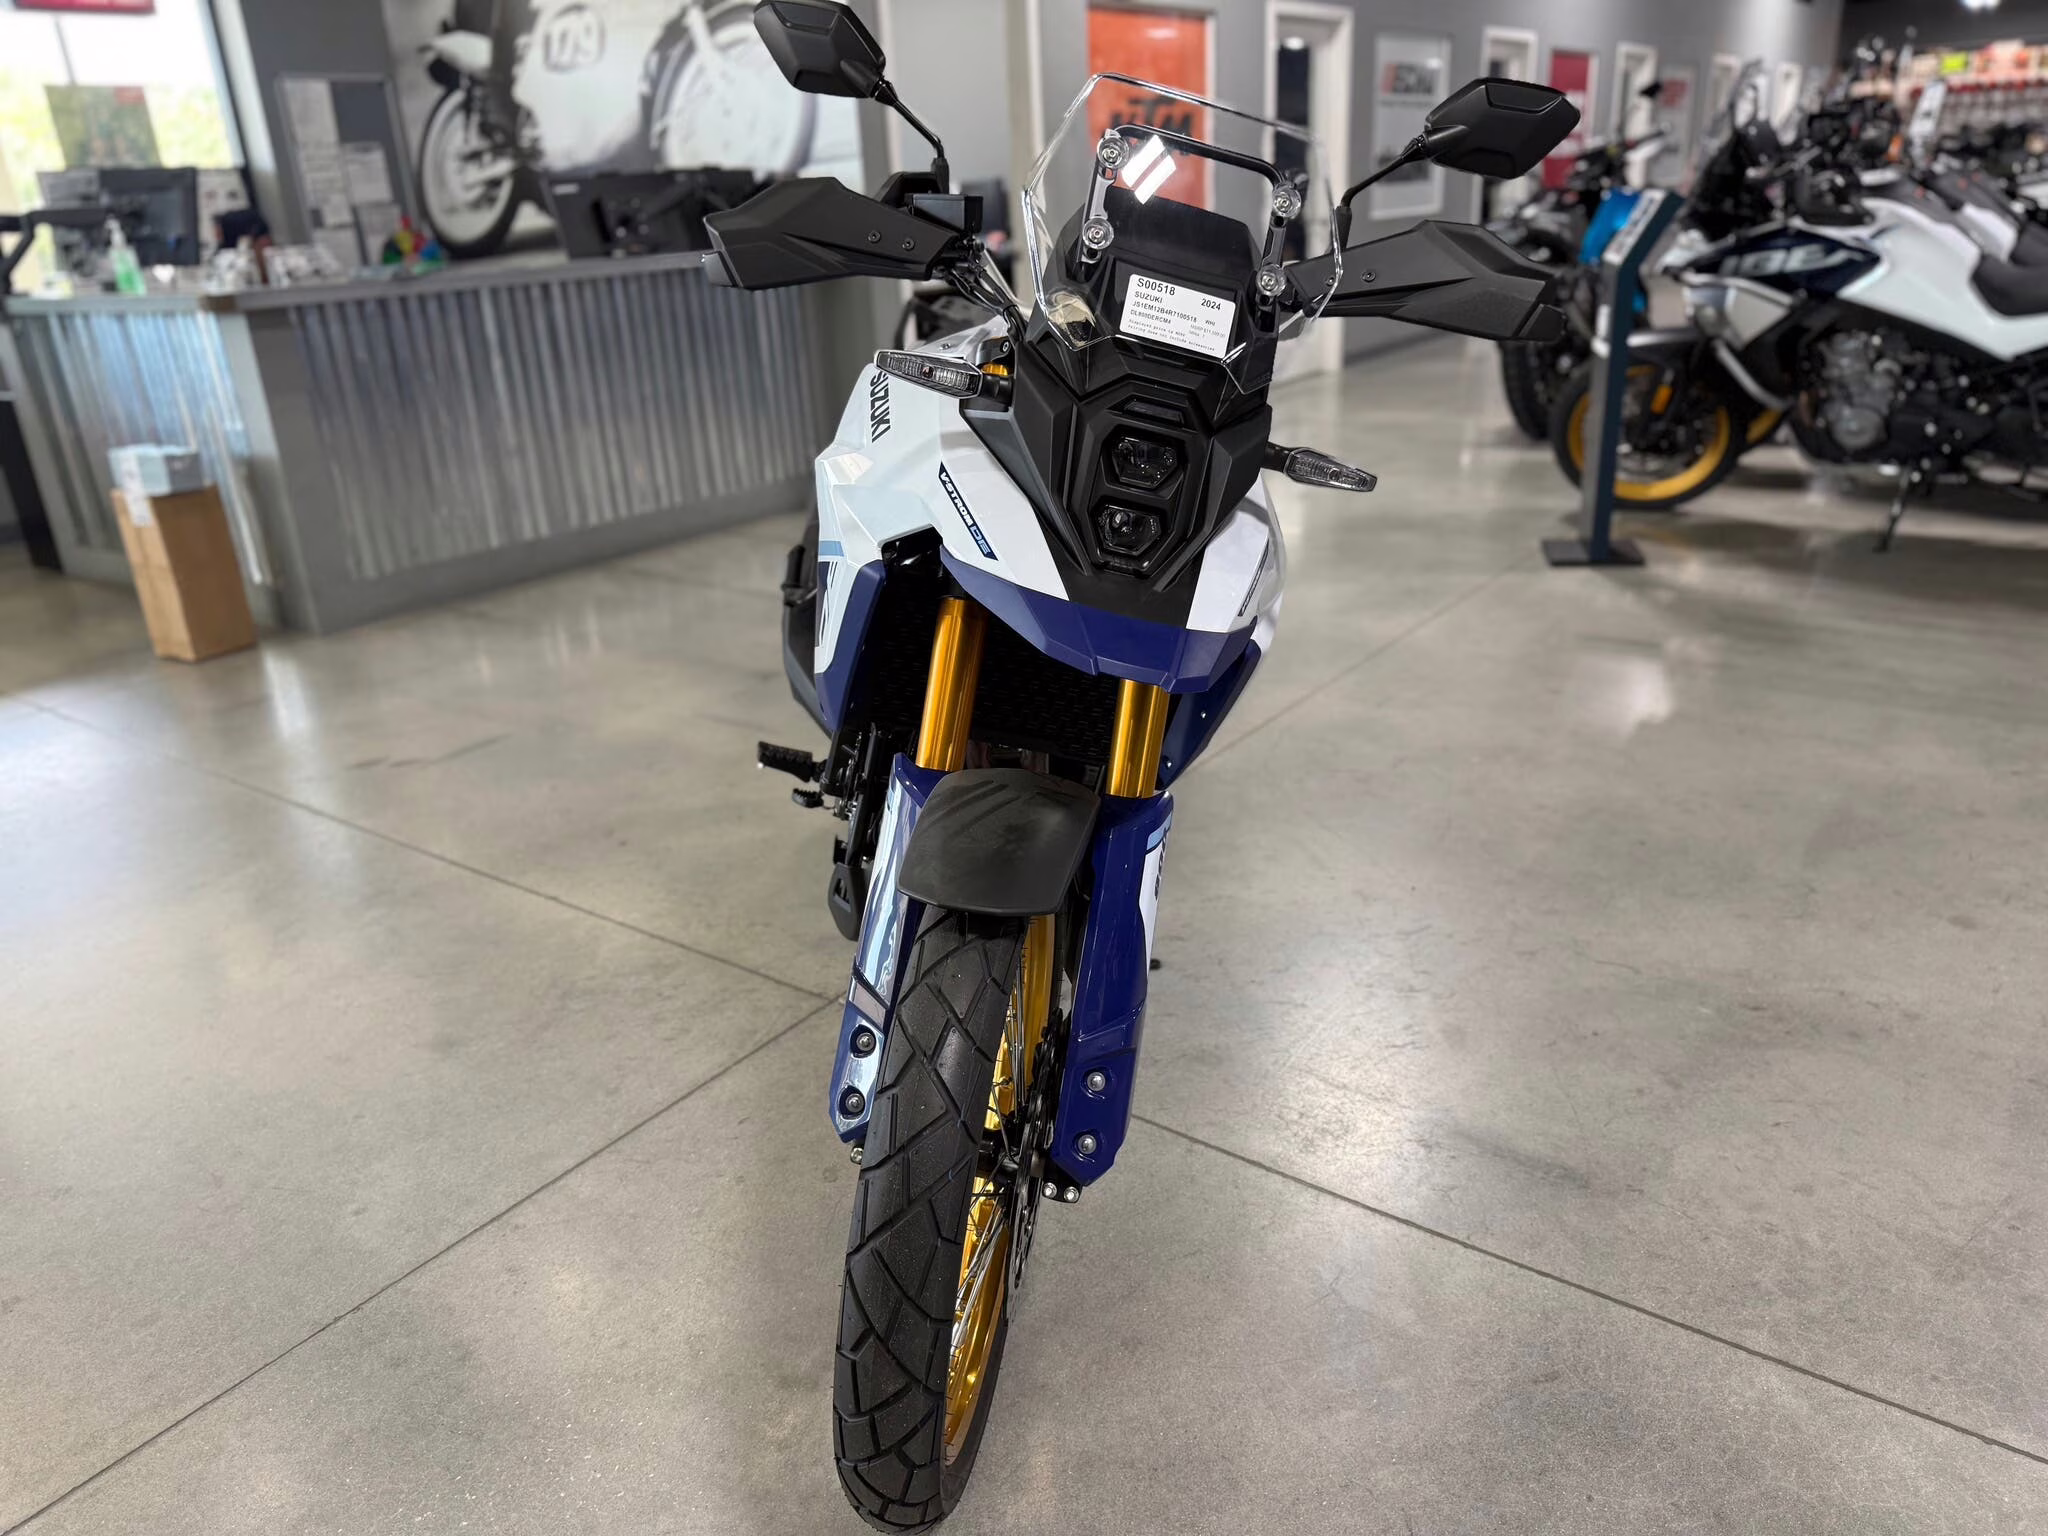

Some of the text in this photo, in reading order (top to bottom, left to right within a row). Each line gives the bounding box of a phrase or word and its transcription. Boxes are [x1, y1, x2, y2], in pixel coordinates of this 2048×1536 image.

[1137, 278, 1175, 295] S00518
[1135, 291, 1163, 303] SUZUKI
[1201, 298, 1221, 311] 2024
[870, 371, 890, 443] SUZUKI
